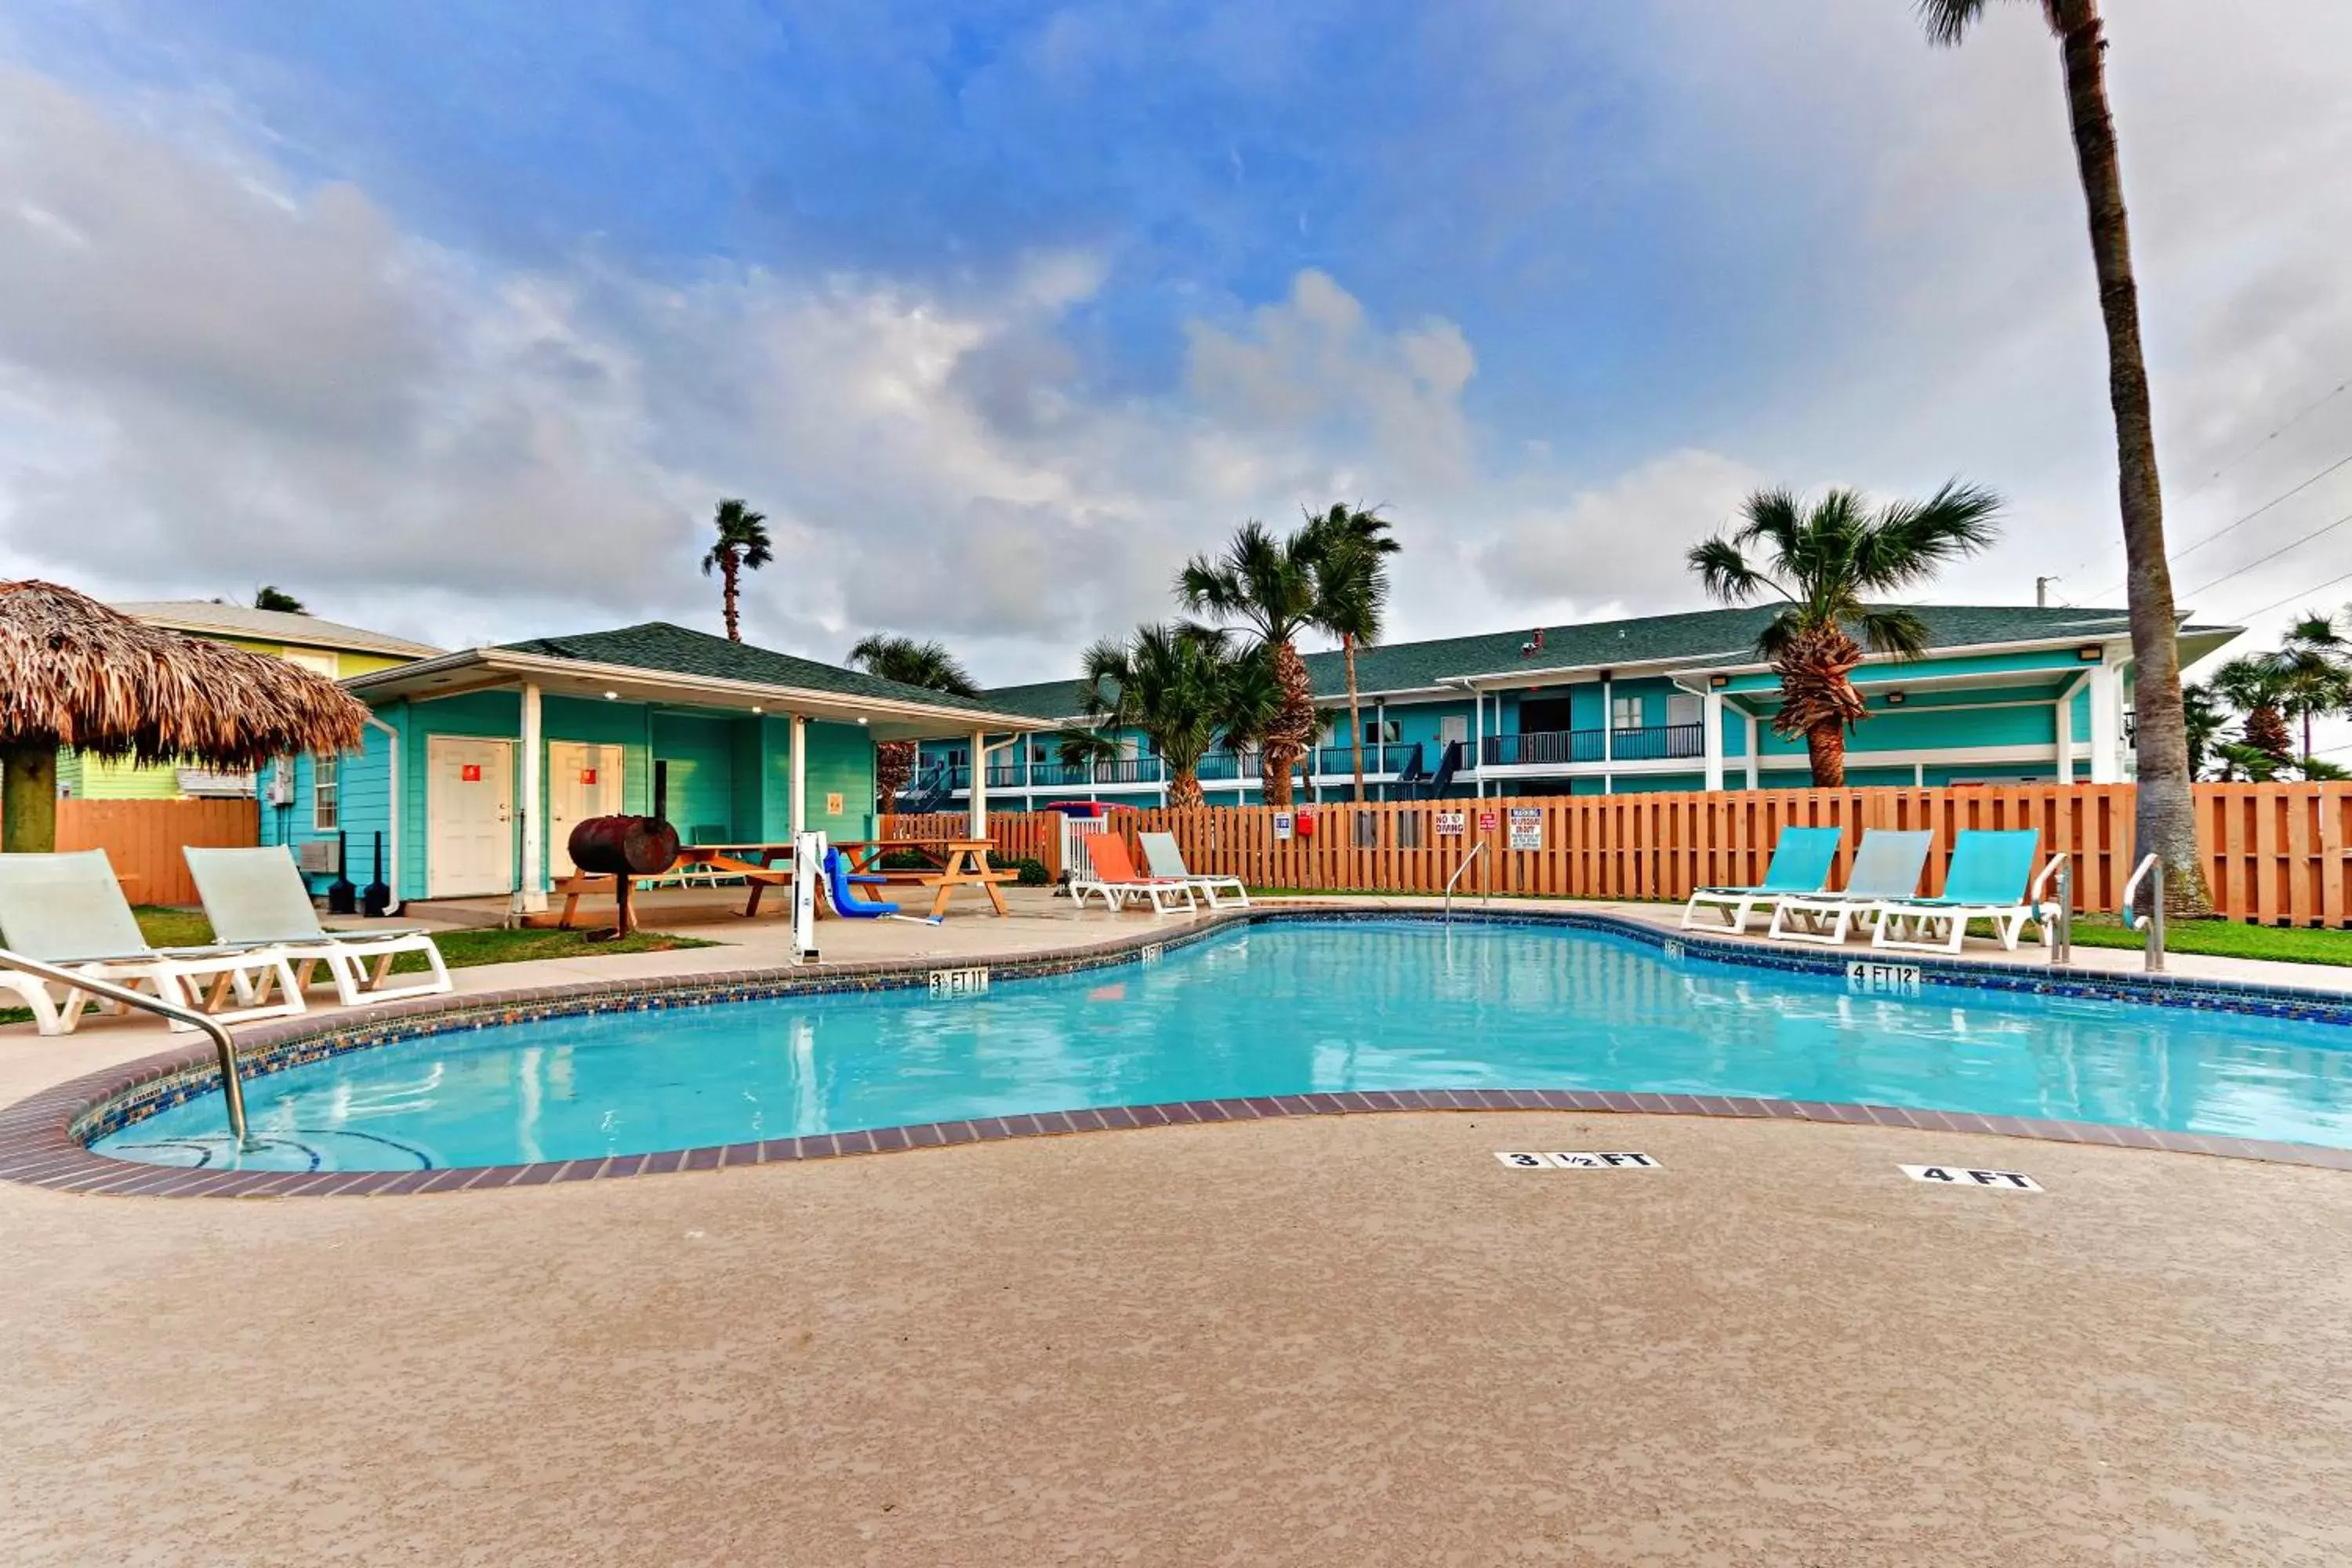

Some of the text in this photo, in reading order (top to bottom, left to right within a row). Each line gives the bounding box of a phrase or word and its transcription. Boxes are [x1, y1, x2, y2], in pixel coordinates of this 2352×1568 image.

[1436, 815, 1448, 824] NO
[1436, 824, 1464, 833] DIVING
[931, 973, 941, 987] 3
[952, 971, 968, 987] FT
[1853, 964, 1865, 979] 4
[1873, 966, 1893, 981] FT
[1509, 1153, 1540, 1167] 3
[1599, 1153, 1651, 1167] FT
[1923, 1167, 2029, 1188] 4 FT
